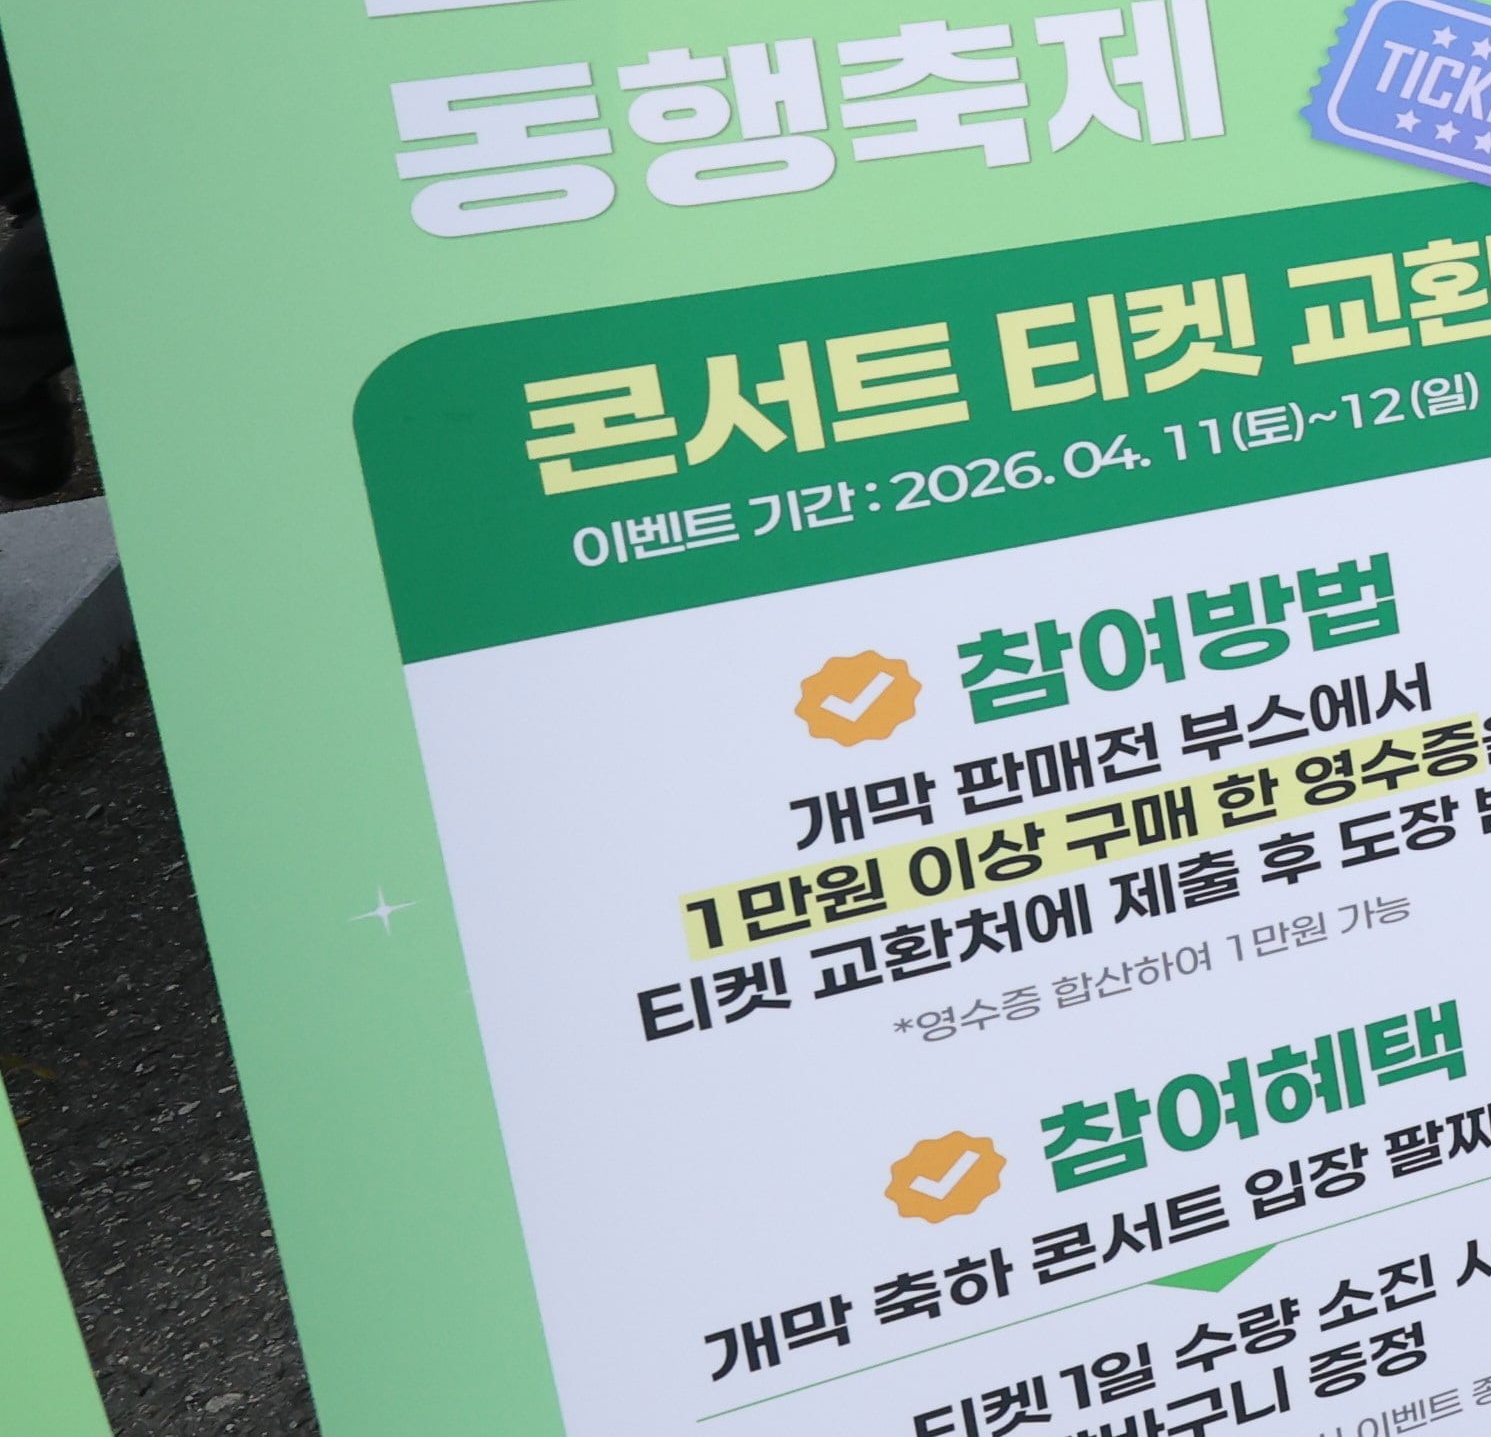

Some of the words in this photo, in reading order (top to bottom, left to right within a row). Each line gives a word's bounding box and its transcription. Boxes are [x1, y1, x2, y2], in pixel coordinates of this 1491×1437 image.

[525, 323, 969, 495] 콘서트
[997, 274, 1262, 411] 티켓
[574, 503, 739, 566] 이벤트
[749, 482, 855, 535] 기간
[890, 451, 1055, 511] 2026.
[1064, 435, 1151, 478] 04.
[957, 553, 1401, 723] 참여방법
[790, 772, 935, 850] 개막
[954, 722, 1161, 812] 판매전
[1181, 662, 1431, 763] 부스에서
[638, 957, 791, 1041] 티켓
[811, 883, 1092, 999] 교환처에
[1110, 850, 1239, 919] 제출
[1259, 832, 1321, 884] 후
[1340, 795, 1458, 868] 도장
[687, 858, 887, 948] 1만원
[909, 822, 1045, 896] 이상
[1066, 786, 1198, 860] 구매
[1216, 768, 1278, 828] 한
[1052, 941, 1211, 1009] 합산하여
[1226, 912, 1328, 961] 1만원
[1338, 894, 1412, 941] 가능
[1041, 1000, 1467, 1193] 참여혜택
[705, 1295, 852, 1381] 개막
[874, 1248, 1013, 1324] 축하
[1033, 1185, 1229, 1284] 콘서트
[1245, 1143, 1368, 1219] 입장
[914, 1376, 1051, 1437] 티켓
[1060, 1343, 1155, 1409] 1일
[1176, 1298, 1300, 1372] 수량
[1319, 1254, 1436, 1331] 소진
[1310, 1321, 1426, 1397] 증정
